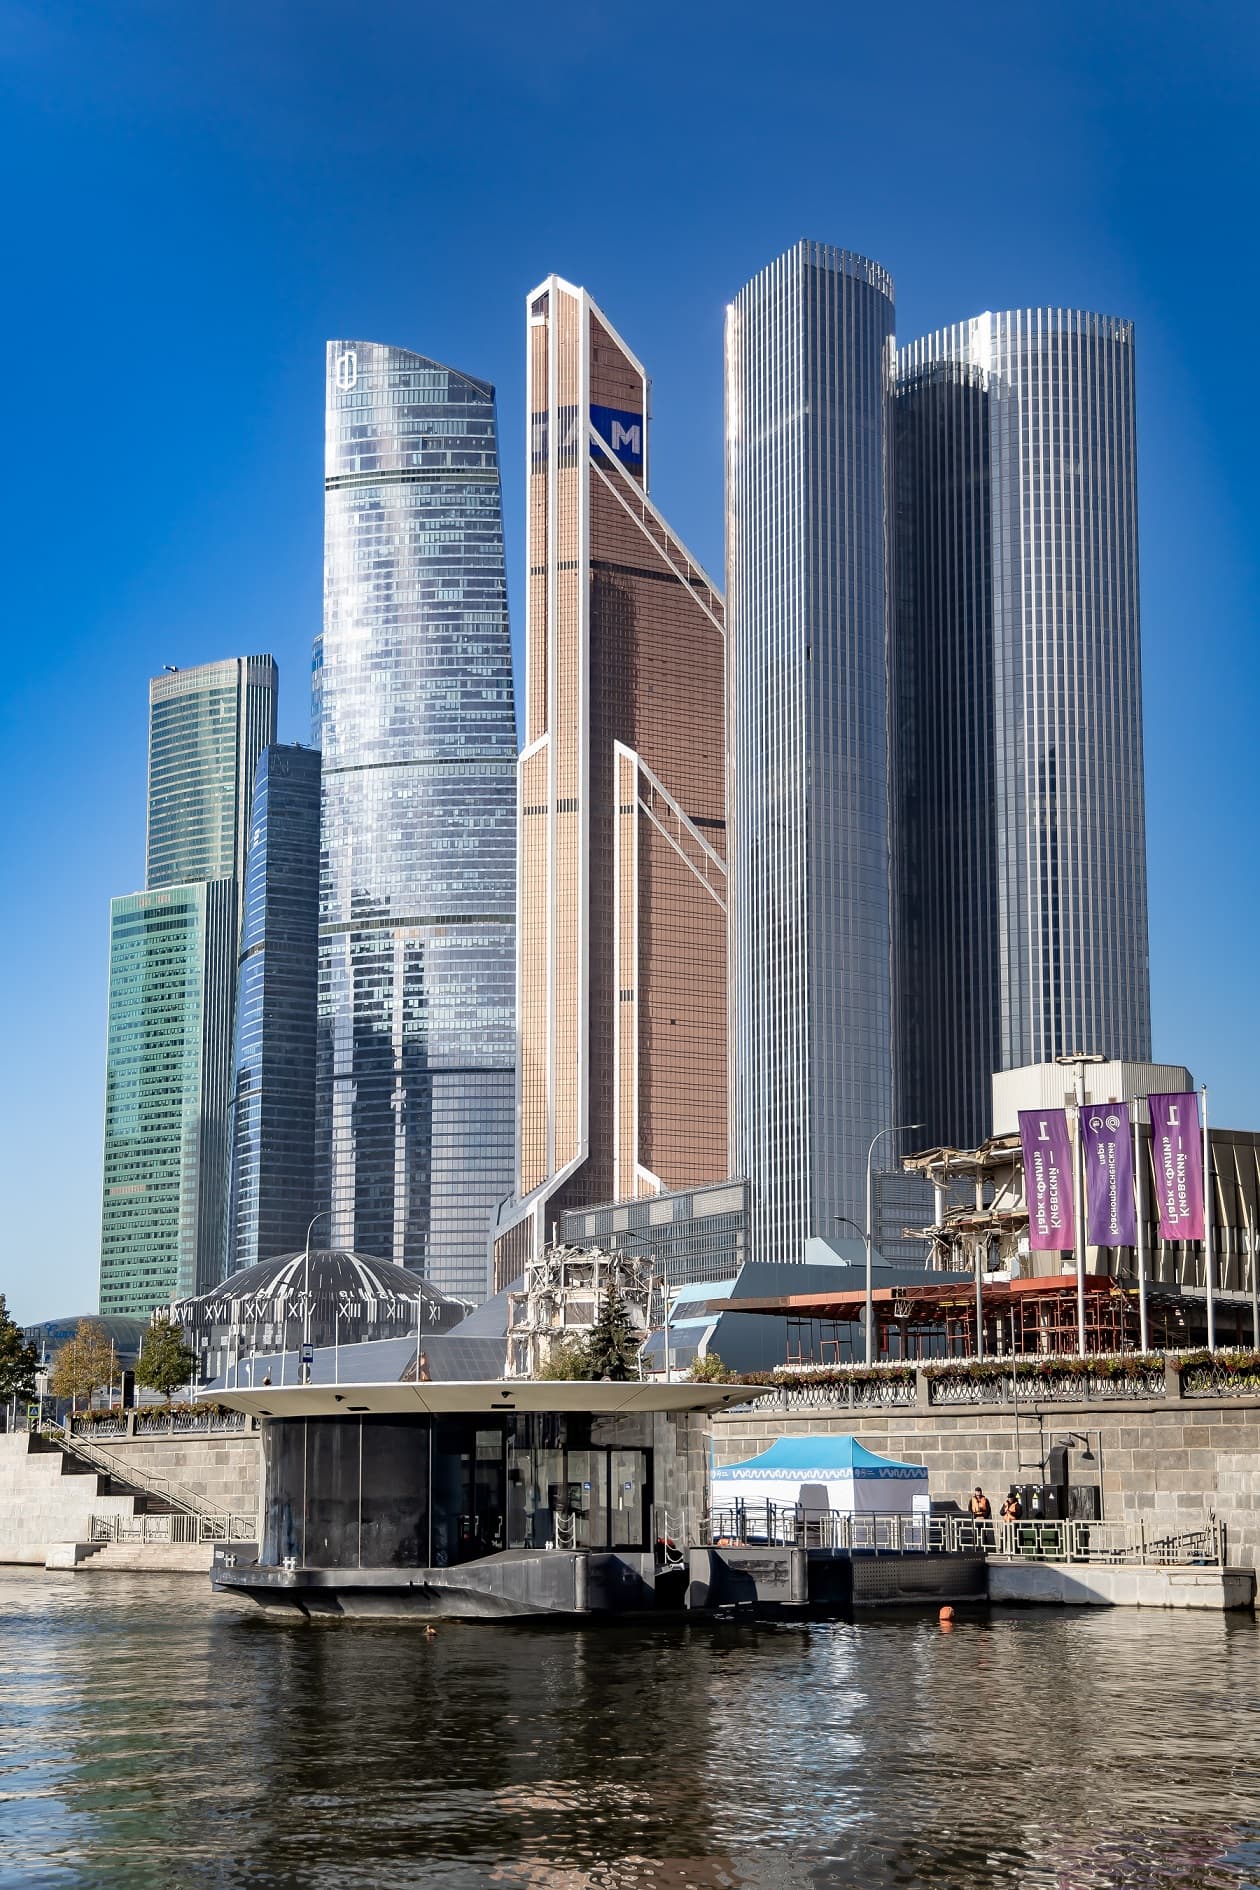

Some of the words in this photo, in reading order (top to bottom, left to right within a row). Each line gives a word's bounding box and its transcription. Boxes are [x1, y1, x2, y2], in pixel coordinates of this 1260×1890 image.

[174, 1306, 193, 1322] XVII
[205, 1304, 227, 1320] XVI
[245, 1302, 268, 1319] XV
[288, 1302, 316, 1318] XIV
[338, 1302, 361, 1318] XIII
[386, 1303, 404, 1319] XII
[428, 1305, 441, 1321] XI
